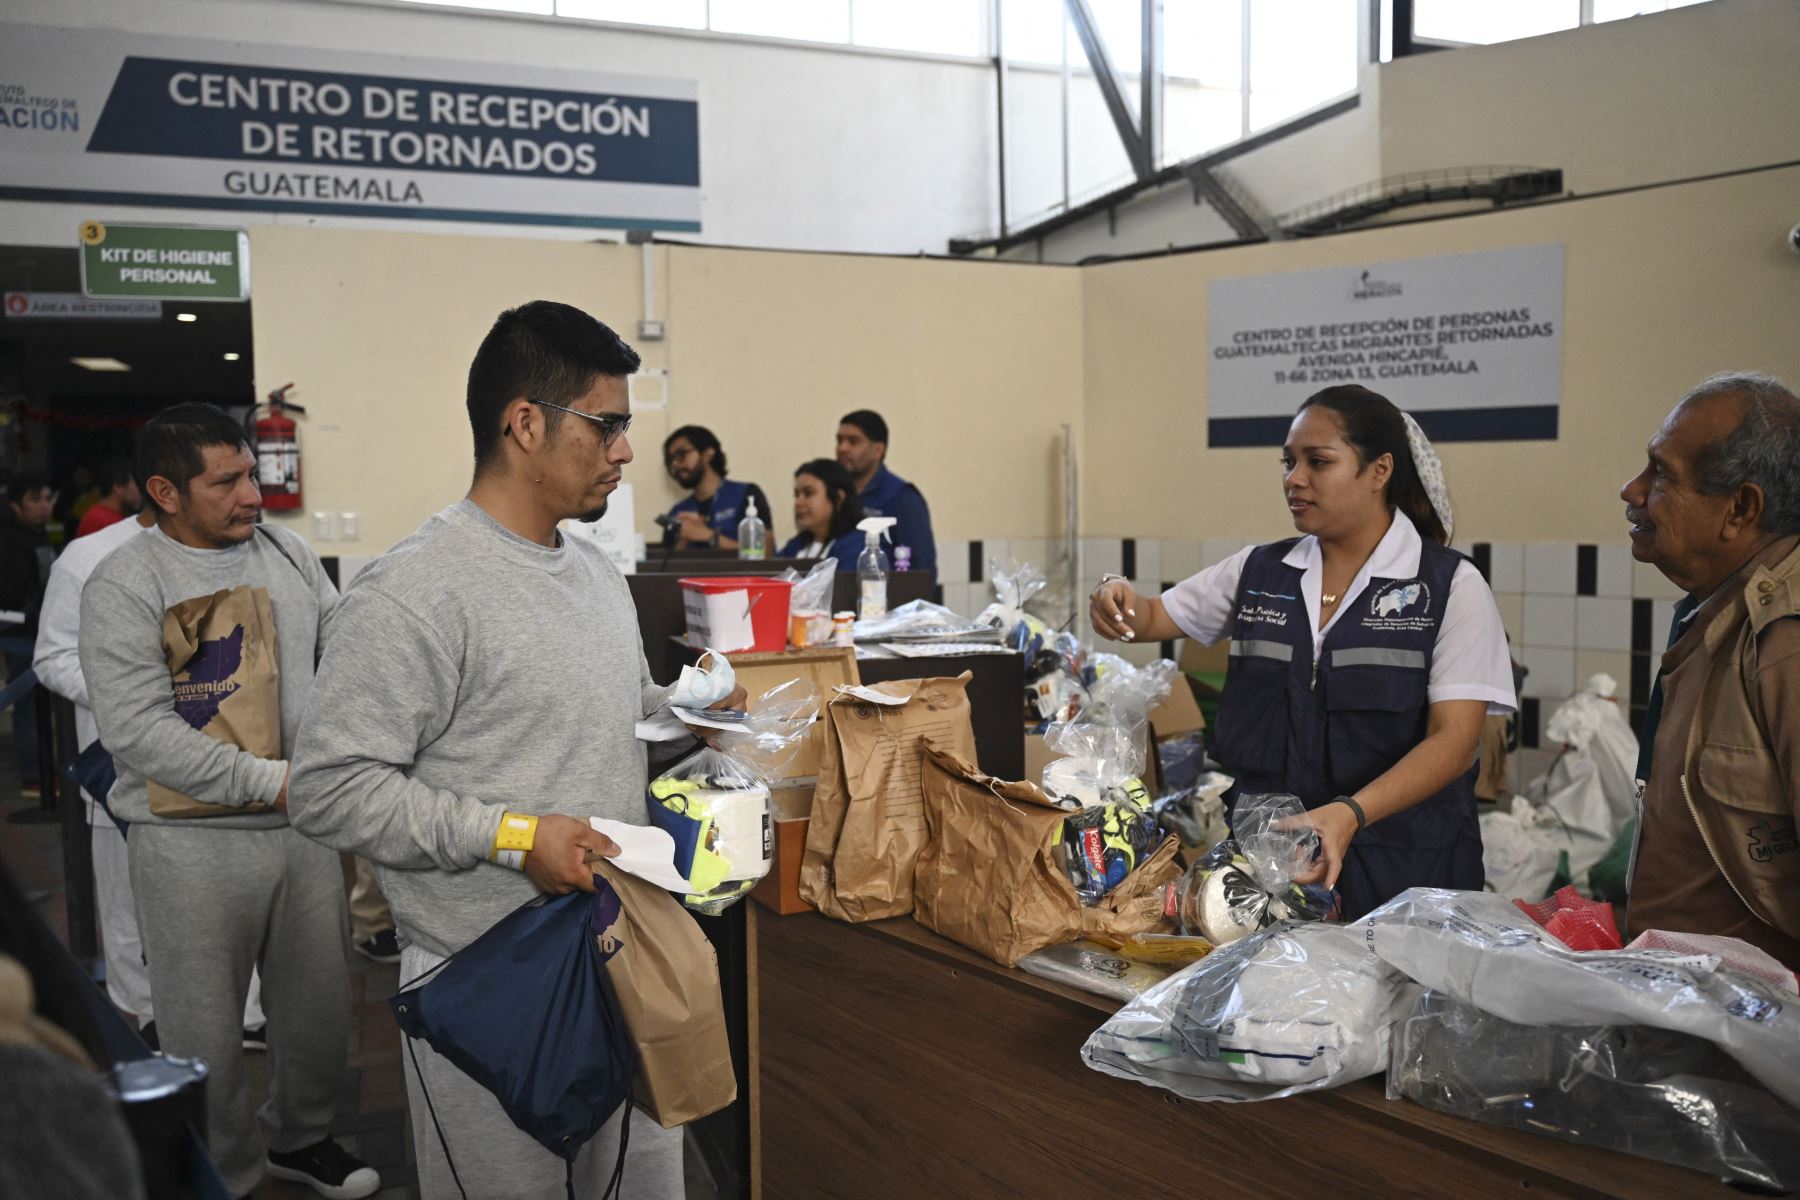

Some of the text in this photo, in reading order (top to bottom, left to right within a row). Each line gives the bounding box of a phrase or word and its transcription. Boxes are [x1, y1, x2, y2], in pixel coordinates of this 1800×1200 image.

[168, 72, 650, 138] CENTRO DE RECEPCIÓN
[241, 120, 597, 175] DE RETORNADOS
[223, 170, 423, 203] GUATEMALA
[86, 225, 98, 239] 3
[100, 247, 233, 266] KIT DE HIGIENE
[120, 267, 216, 284] PERSONAL
[1232, 308, 1530, 344] CENTRO DE RECEPCIÓN DE PERSONAS
[1214, 322, 1554, 360] GUATEMALTECAS MIGRANTES RETORNADAS
[1297, 344, 1449, 368] AVENIDA HINCAPIÉ,
[1274, 359, 1479, 384] 11-66 ZONA 13, GUATEMALA
[1366, 929, 1374, 941] TO
